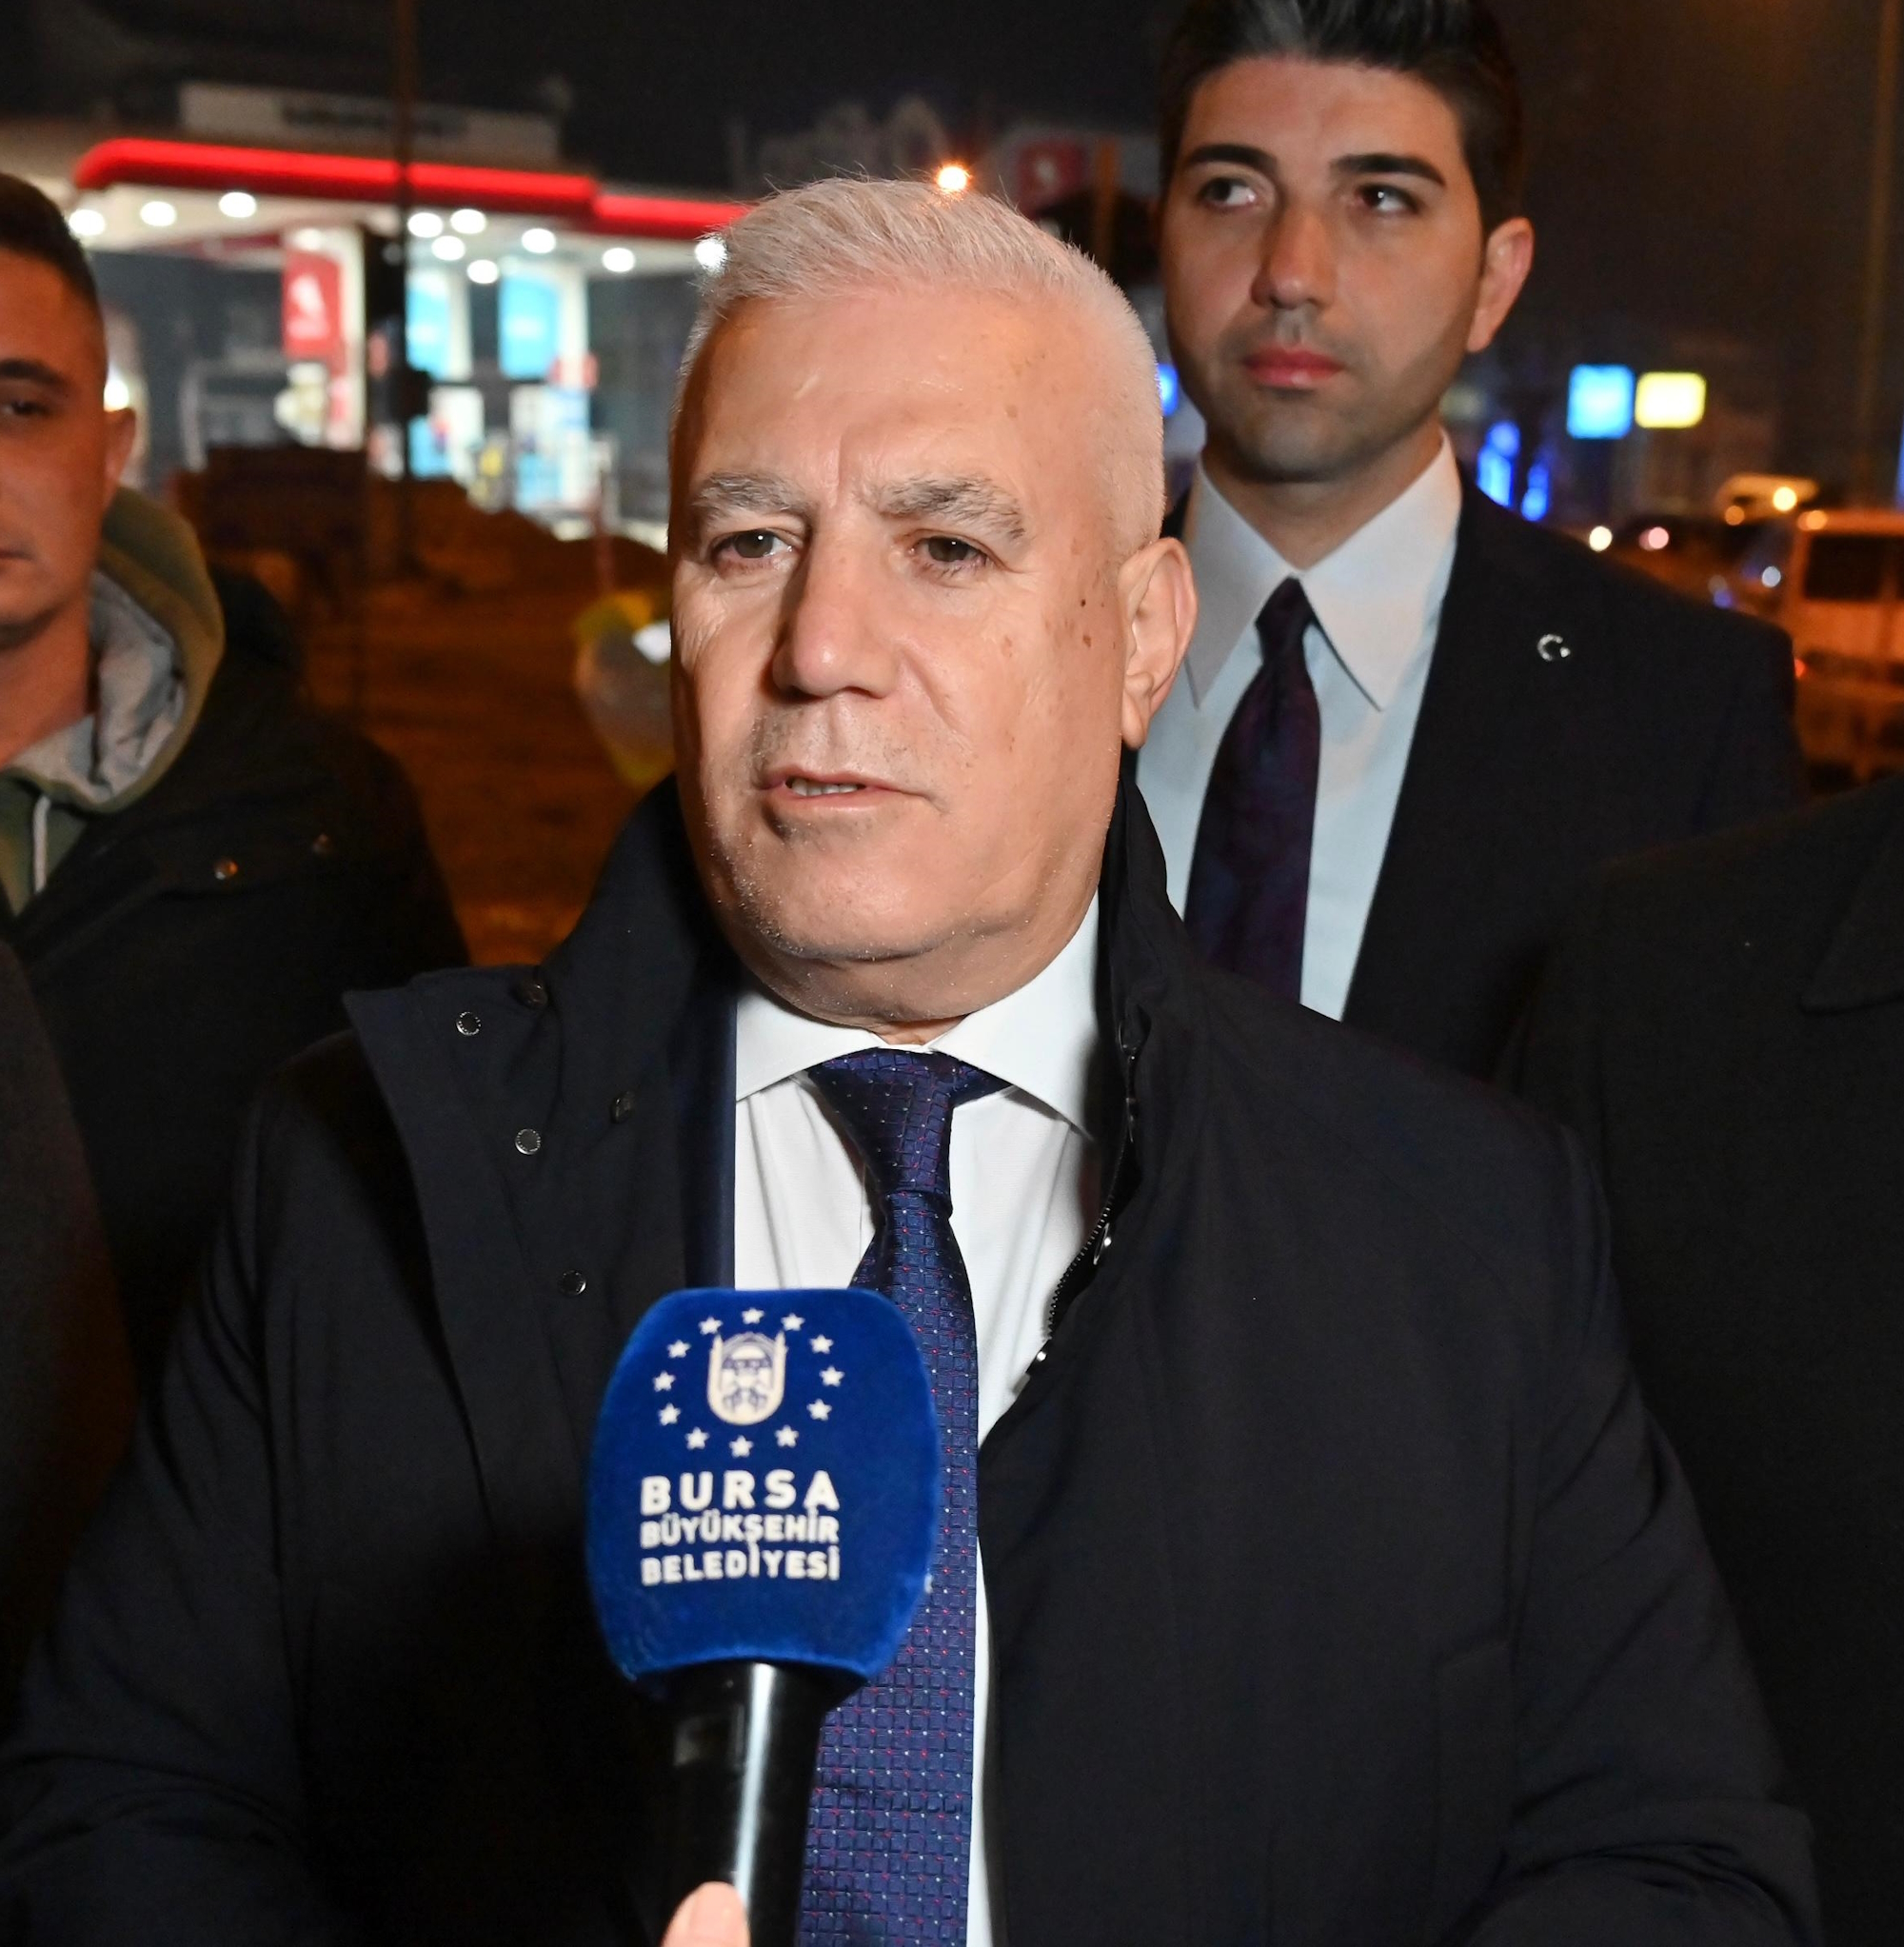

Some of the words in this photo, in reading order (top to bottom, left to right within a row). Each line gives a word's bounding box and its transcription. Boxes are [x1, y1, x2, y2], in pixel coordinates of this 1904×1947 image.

[641, 1469, 840, 1515] BURSA
[641, 1508, 840, 1549] BÜYÜKŞEHİR
[641, 1543, 840, 1586] BELEDİYESİ
